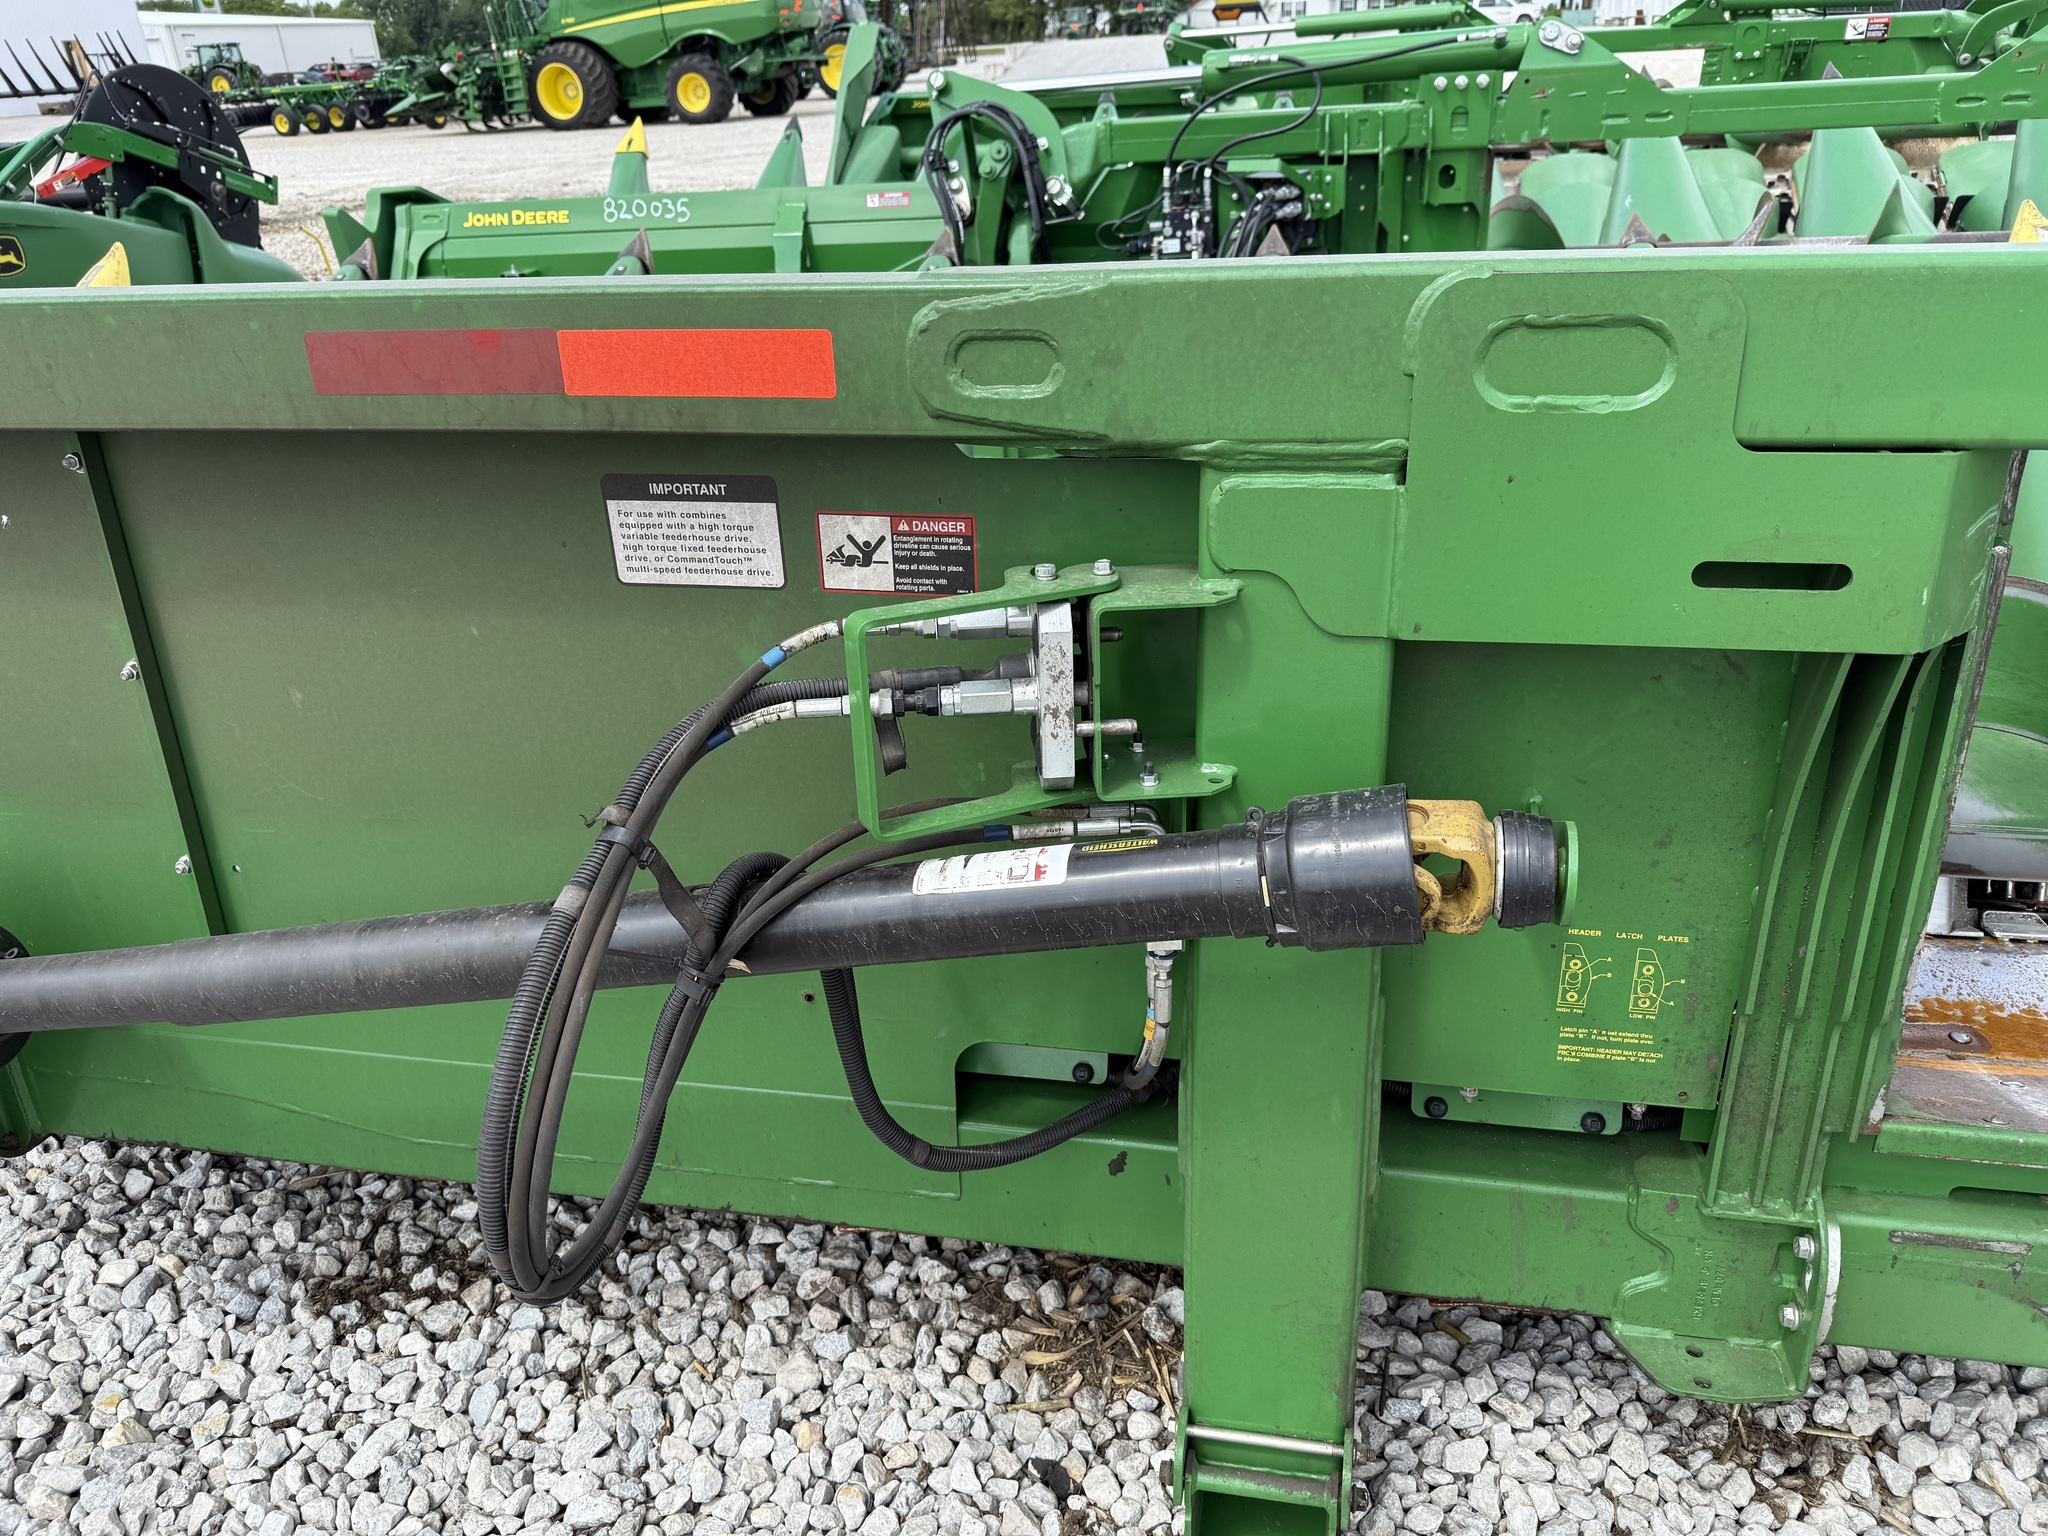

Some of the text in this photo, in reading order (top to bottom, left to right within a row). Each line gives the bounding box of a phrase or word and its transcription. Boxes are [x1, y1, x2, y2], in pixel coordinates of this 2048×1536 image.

[603, 197, 690, 222] 820035
[463, 210, 570, 228] JOHN DEERE
[649, 483, 727, 495] IMPORTANT
[617, 510, 633, 518] For
[657, 511, 676, 519] with
[680, 511, 726, 520] combines
[619, 522, 662, 530] equipped
[666, 522, 686, 530] with
[699, 523, 719, 532] high
[723, 524, 754, 532] torque
[912, 521, 965, 532] DANGER
[662, 533, 721, 541] feederhouse
[893, 535, 932, 543] Entanglement
[623, 544, 643, 552] high
[647, 544, 677, 553] torque
[707, 545, 766, 554] feederhouse
[625, 554, 651, 563] drive,
[626, 565, 774, 577] multi-speed feederhouse drive.
[896, 584, 917, 592] rotating
[1658, 935, 1689, 943] PLATES
